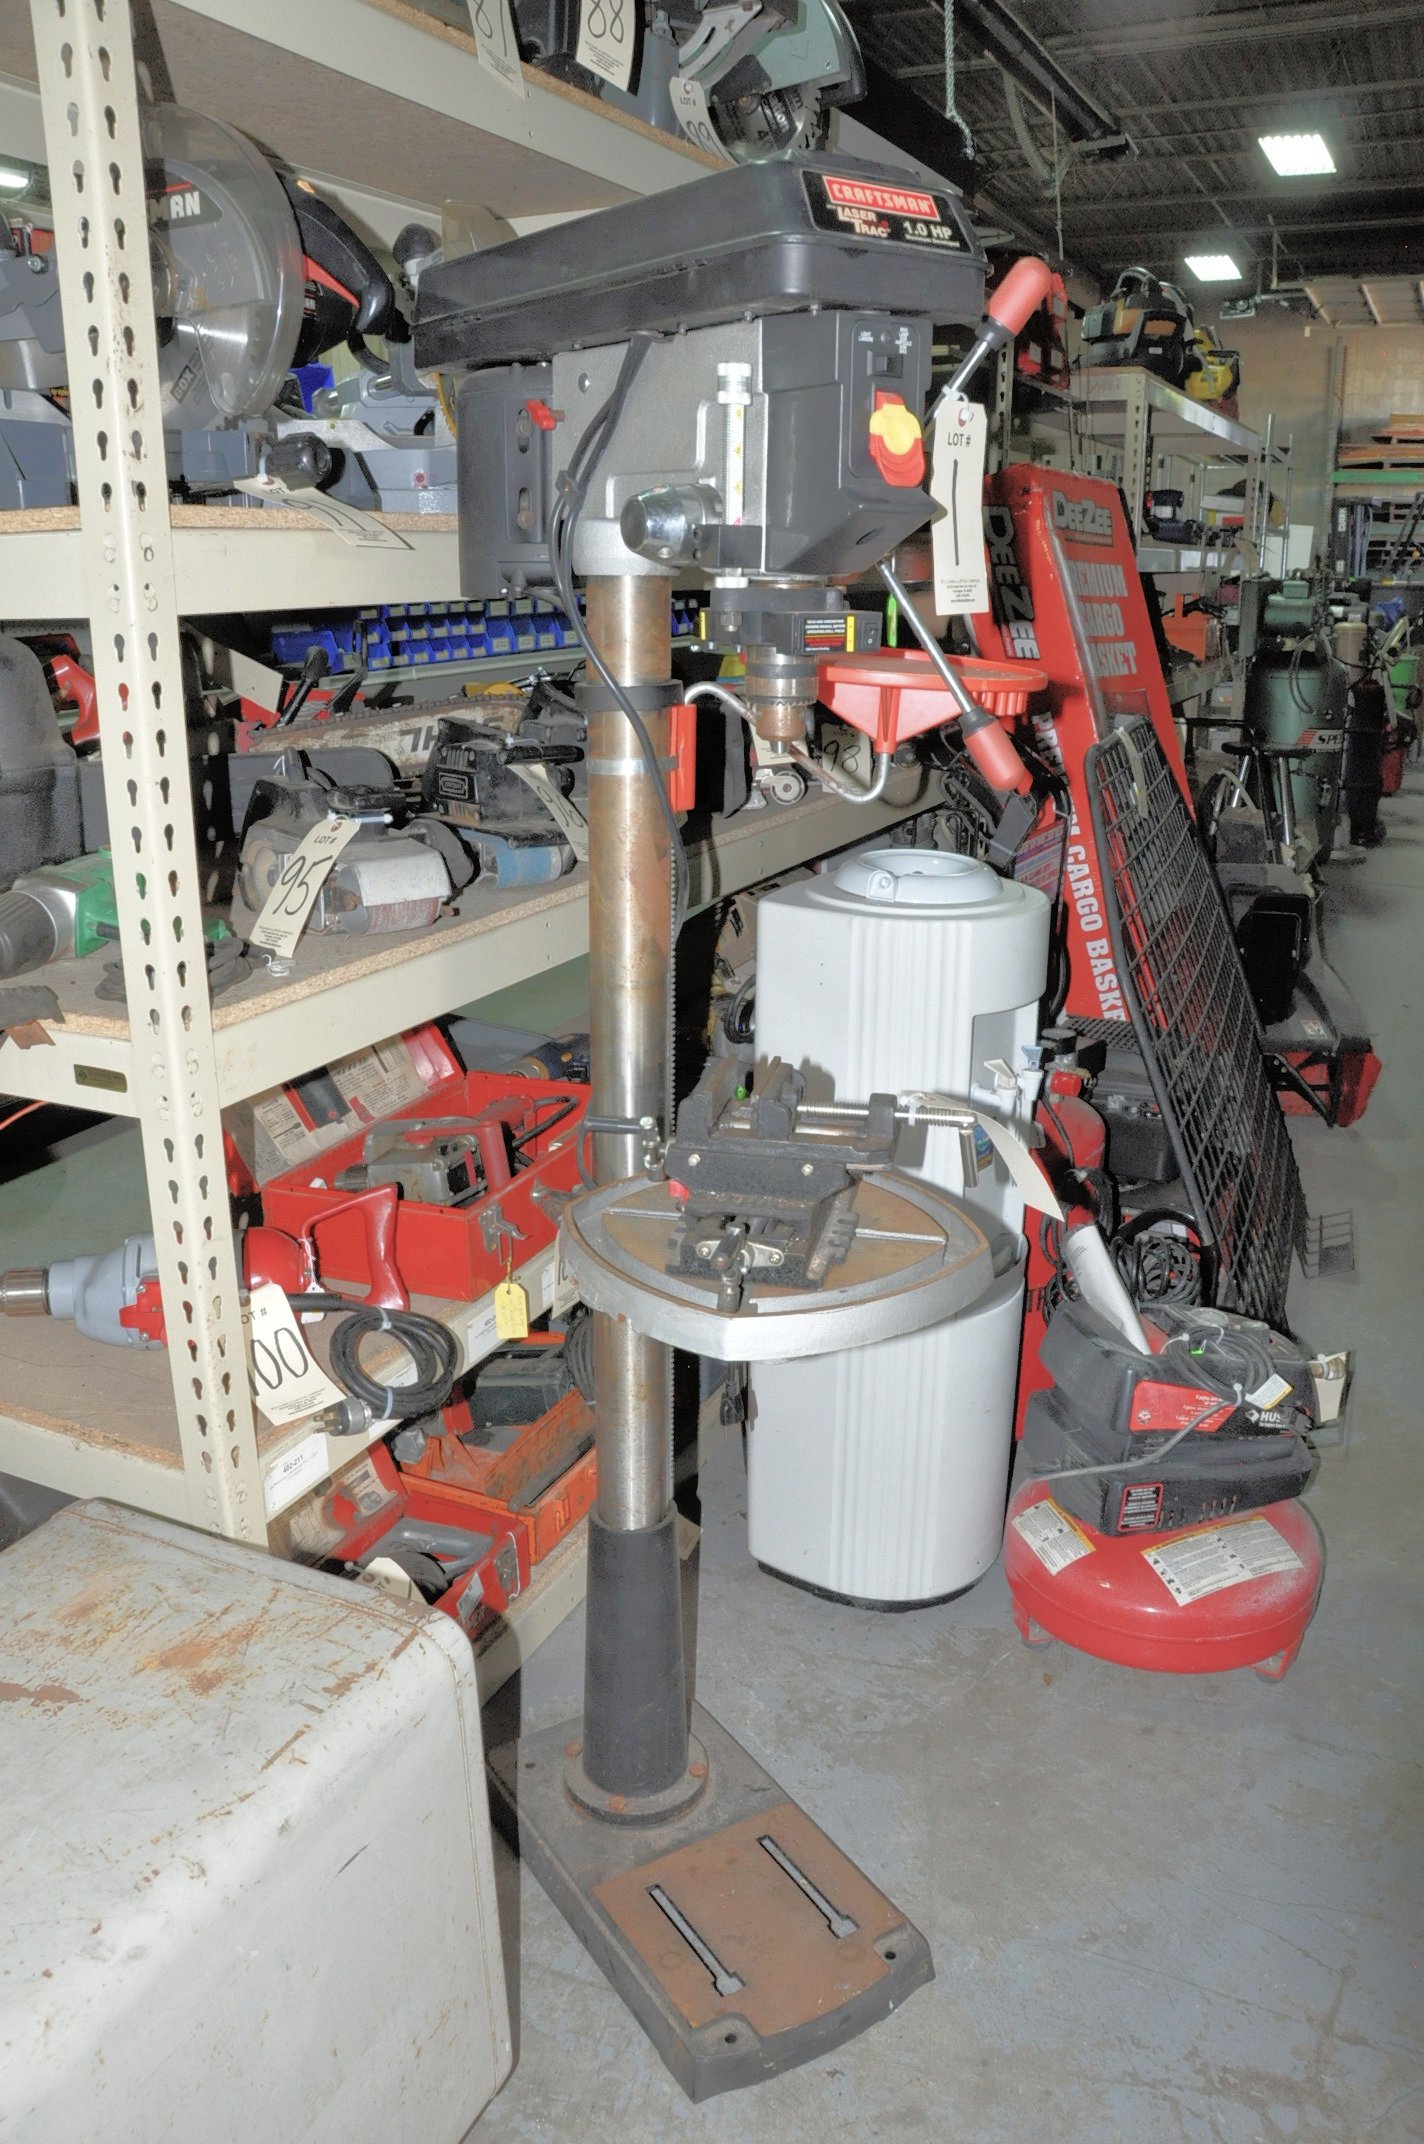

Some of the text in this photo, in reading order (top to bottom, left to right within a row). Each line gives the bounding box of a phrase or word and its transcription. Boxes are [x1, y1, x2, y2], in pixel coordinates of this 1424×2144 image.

[831, 183, 932, 214] CRAFTSMAN
[836, 206, 877, 223] LASER
[852, 219, 889, 238] TRAC
[903, 221, 952, 240] 1.0 HP
[948, 432, 964, 446] LOT
[262, 487, 286, 496] LOT
[823, 740, 861, 774] 98
[313, 835, 330, 845] LOT
[272, 854, 334, 916] 95
[1067, 843, 1103, 932] CARGO
[240, 1310, 256, 1325] OT
